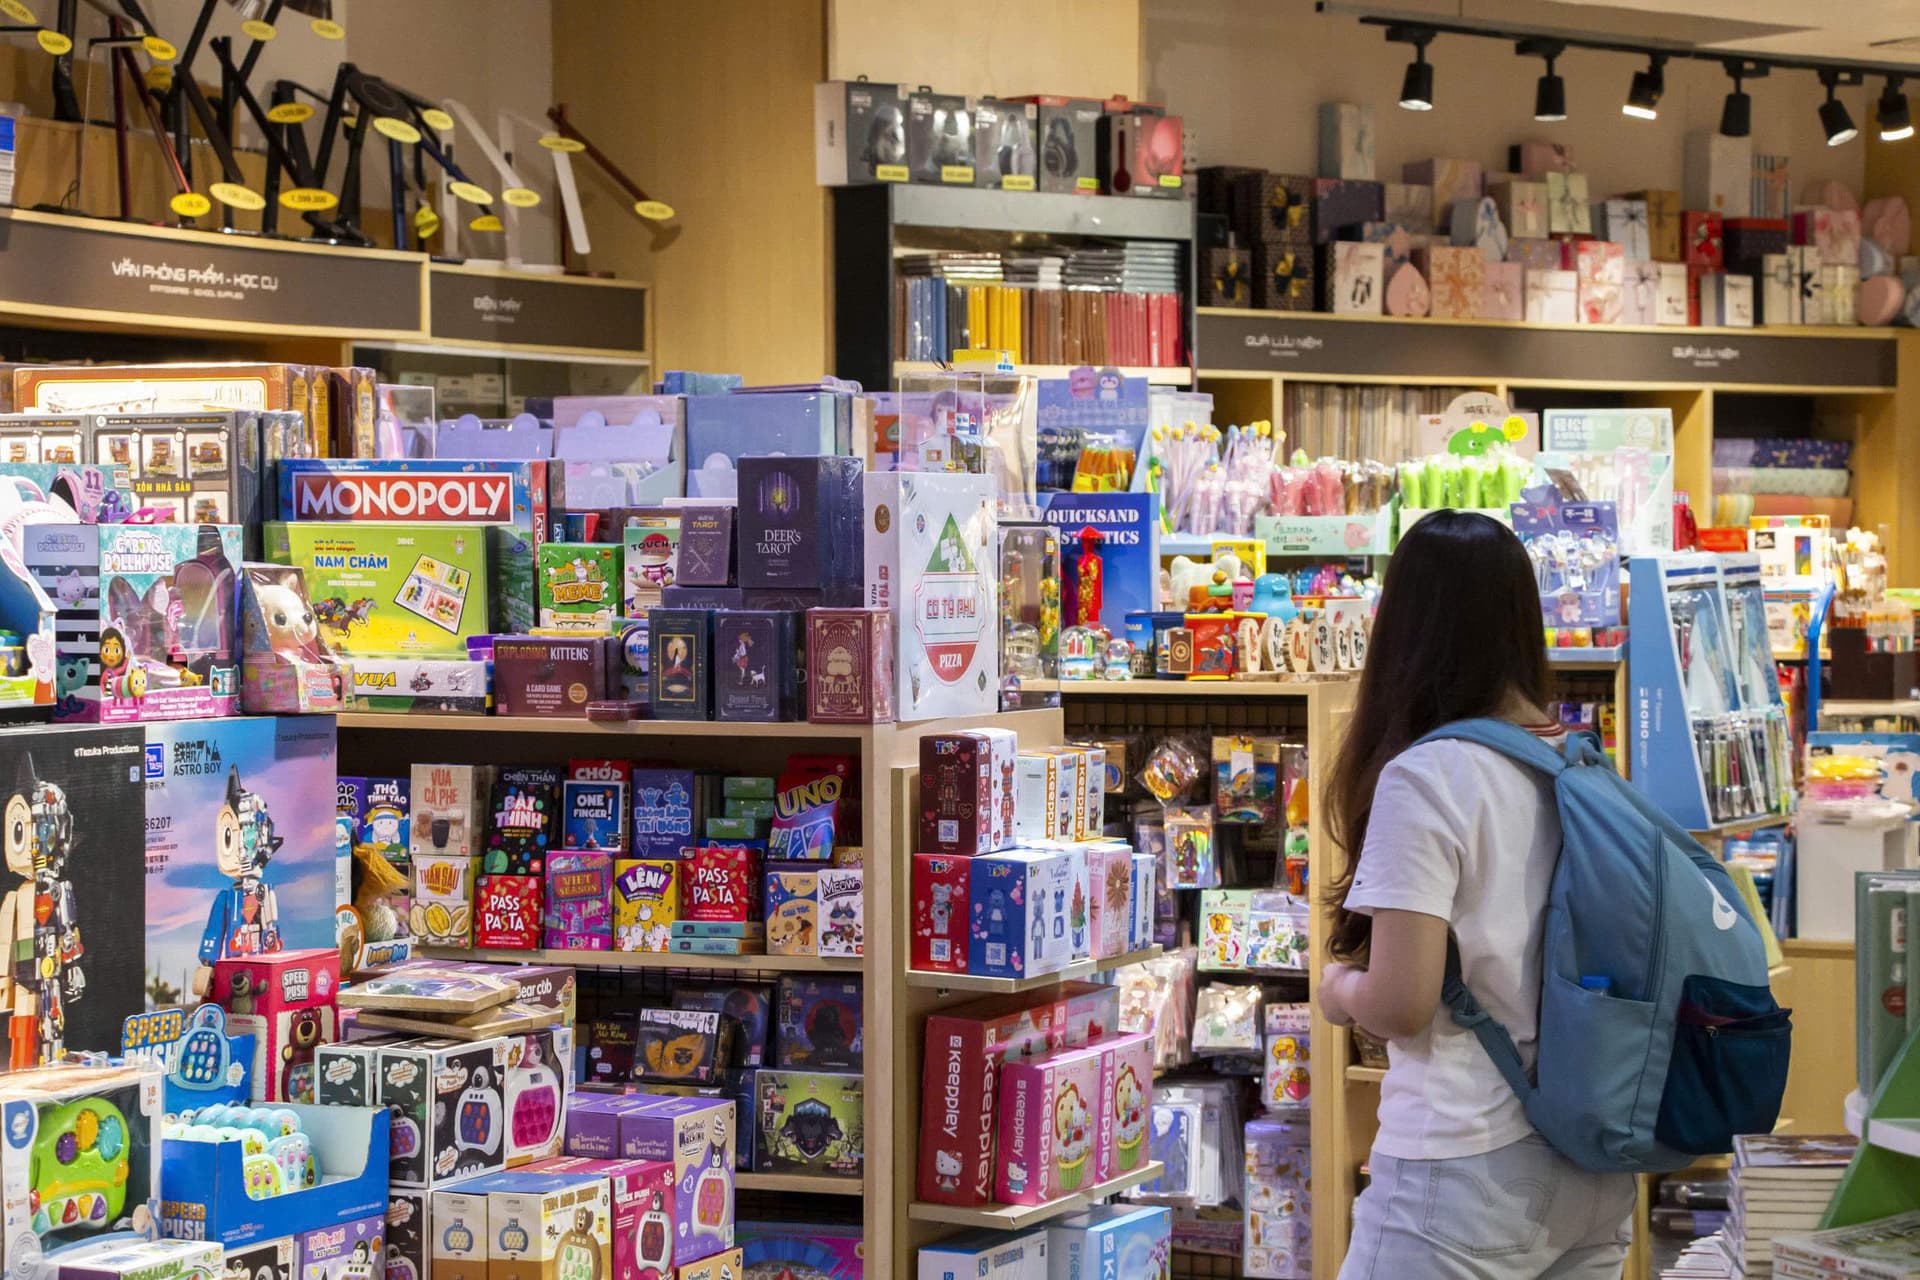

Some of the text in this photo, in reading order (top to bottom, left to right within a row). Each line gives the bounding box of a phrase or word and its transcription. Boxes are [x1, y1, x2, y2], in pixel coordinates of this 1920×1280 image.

[112, 258, 140, 277] VĂN
[142, 262, 186, 282] PHÒNG
[85, 471, 101, 490] 11
[301, 480, 506, 516] MONOPOLY
[1047, 509, 1139, 523] QUICKSAND
[631, 541, 668, 551] TOUCH
[103, 553, 173, 573] DOLLHOUSE
[314, 553, 388, 568] NAM CHÂM
[554, 583, 602, 601] MEME
[497, 646, 589, 661] EXPLODING KITTENS
[940, 654, 962, 669] PIZZA
[546, 685, 562, 693] GAME
[1640, 699, 1649, 739] MONO
[103, 745, 140, 755] Productions
[173, 762, 221, 776] ASTRO BOY
[575, 762, 623, 781] CHỚP
[577, 794, 605, 806] ONE
[776, 774, 844, 820] UNO
[626, 867, 666, 892] LÊN!
[698, 868, 728, 883] PASS
[490, 895, 520, 911] PASS
[693, 885, 734, 905] PASTA
[485, 912, 525, 931] PASTA
[284, 968, 308, 986] SPEED
[286, 985, 307, 1000] PUSH
[537, 978, 552, 995] cub
[125, 1013, 182, 1048] SPEED
[163, 1219, 205, 1241] PUSH
